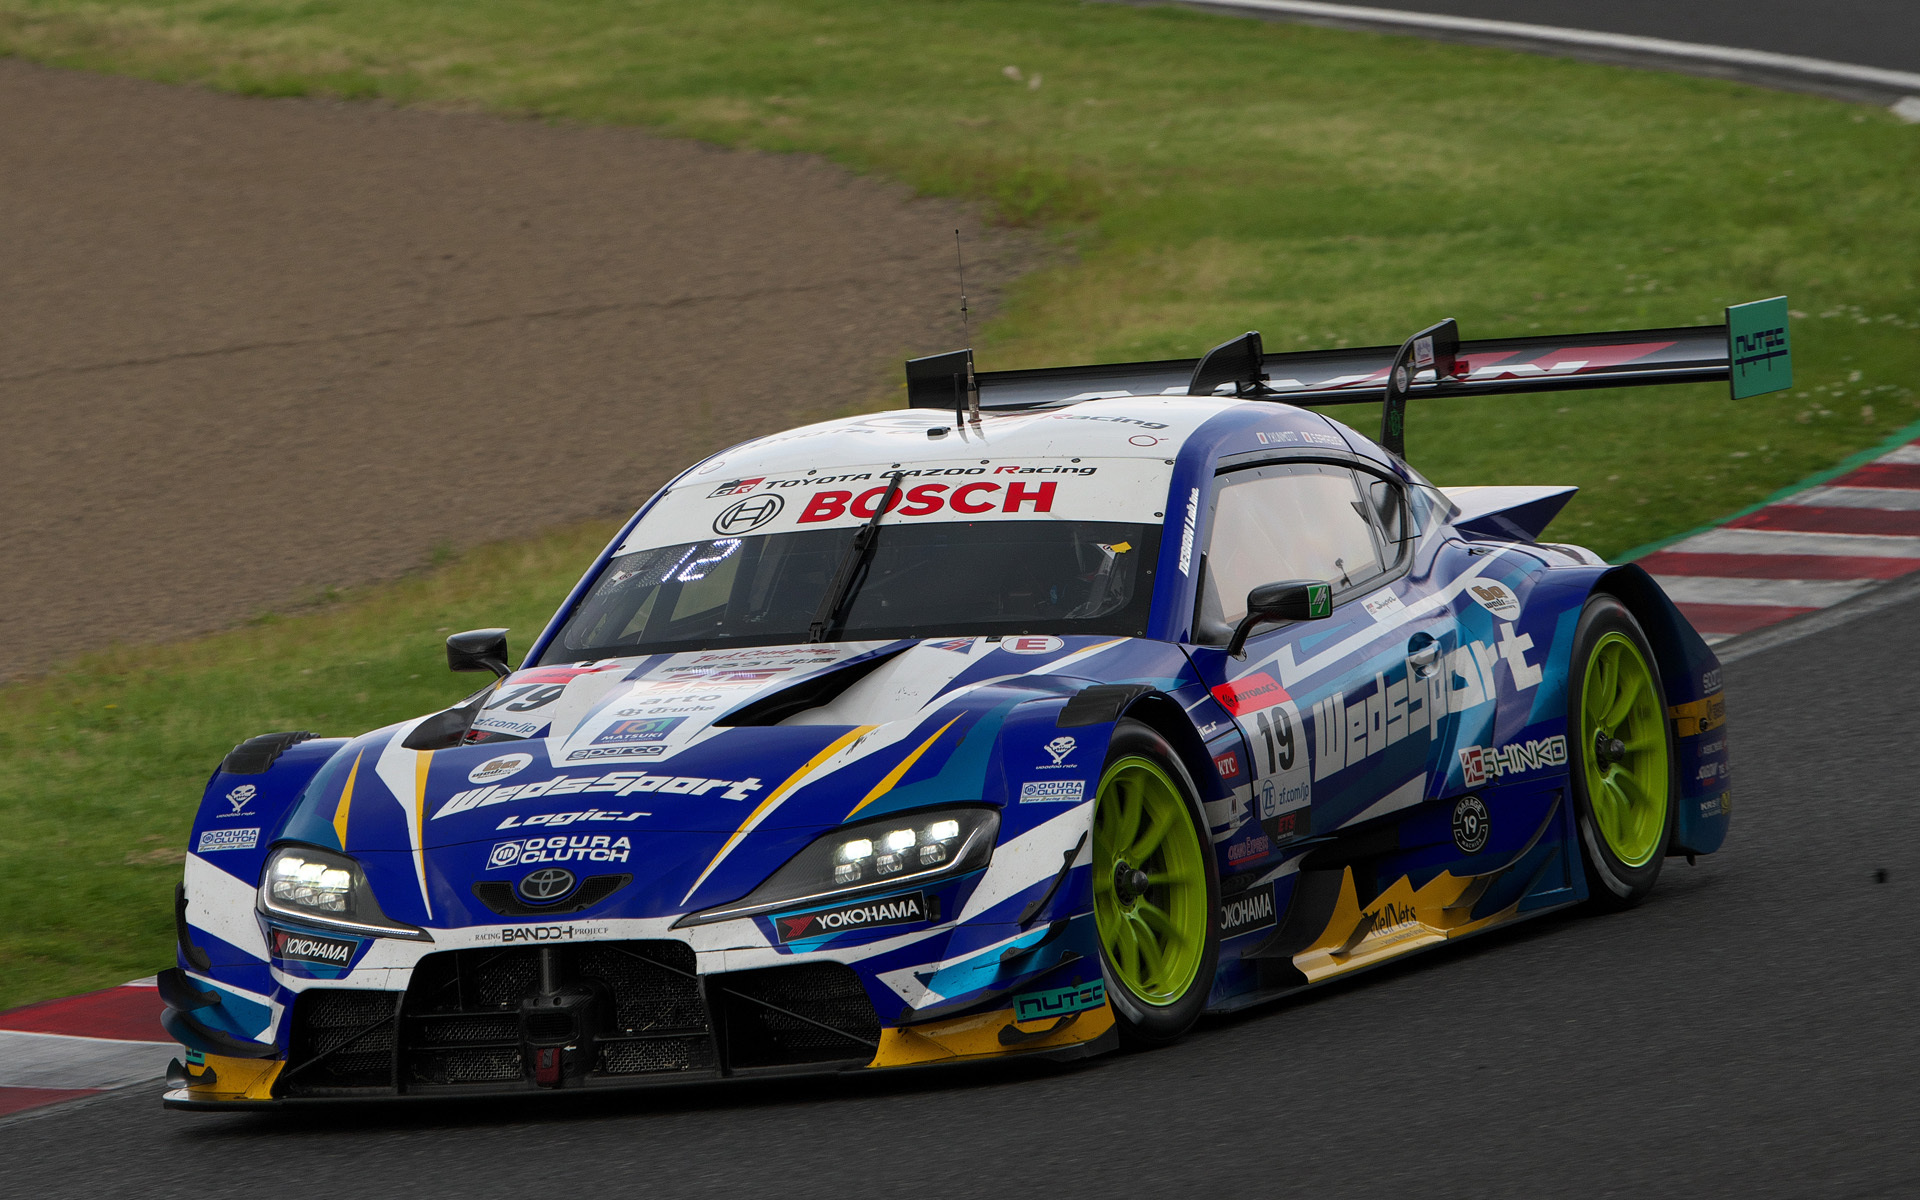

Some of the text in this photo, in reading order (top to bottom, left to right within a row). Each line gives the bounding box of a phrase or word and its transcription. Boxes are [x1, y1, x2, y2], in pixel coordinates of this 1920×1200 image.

[765, 465, 1098, 490] TOYOTA GAZOO Racing
[796, 481, 1058, 524] BOSCH
[482, 683, 567, 712] 19
[1234, 681, 1279, 703] AUTOBACS
[1312, 622, 1543, 783] WedsSport
[473, 717, 537, 734] zf.com/jp
[601, 732, 663, 741] MATSUKI
[1256, 706, 1295, 775] 19
[569, 745, 664, 761] sparco
[1483, 735, 1568, 778] SHINKO
[1218, 757, 1236, 776] KTC
[431, 771, 763, 821] WedsSport
[1037, 788, 1082, 796] CLUTCH
[1038, 782, 1083, 790] OGURA
[1279, 782, 1310, 805] zf.com/jp
[1457, 798, 1482, 815] GARAGE
[495, 808, 652, 831] Logics
[1464, 815, 1477, 835] 19
[214, 836, 257, 844] CLUTCH
[216, 829, 257, 838] OGURA
[524, 836, 631, 850] OGURA
[520, 848, 630, 864] CLUTCH
[815, 898, 920, 931] YOKOHAMA
[1220, 892, 1273, 930] OKOHAMA
[475, 925, 609, 943] RACING BANDOH PROJECT
[285, 937, 349, 962] YOKOHAMA
